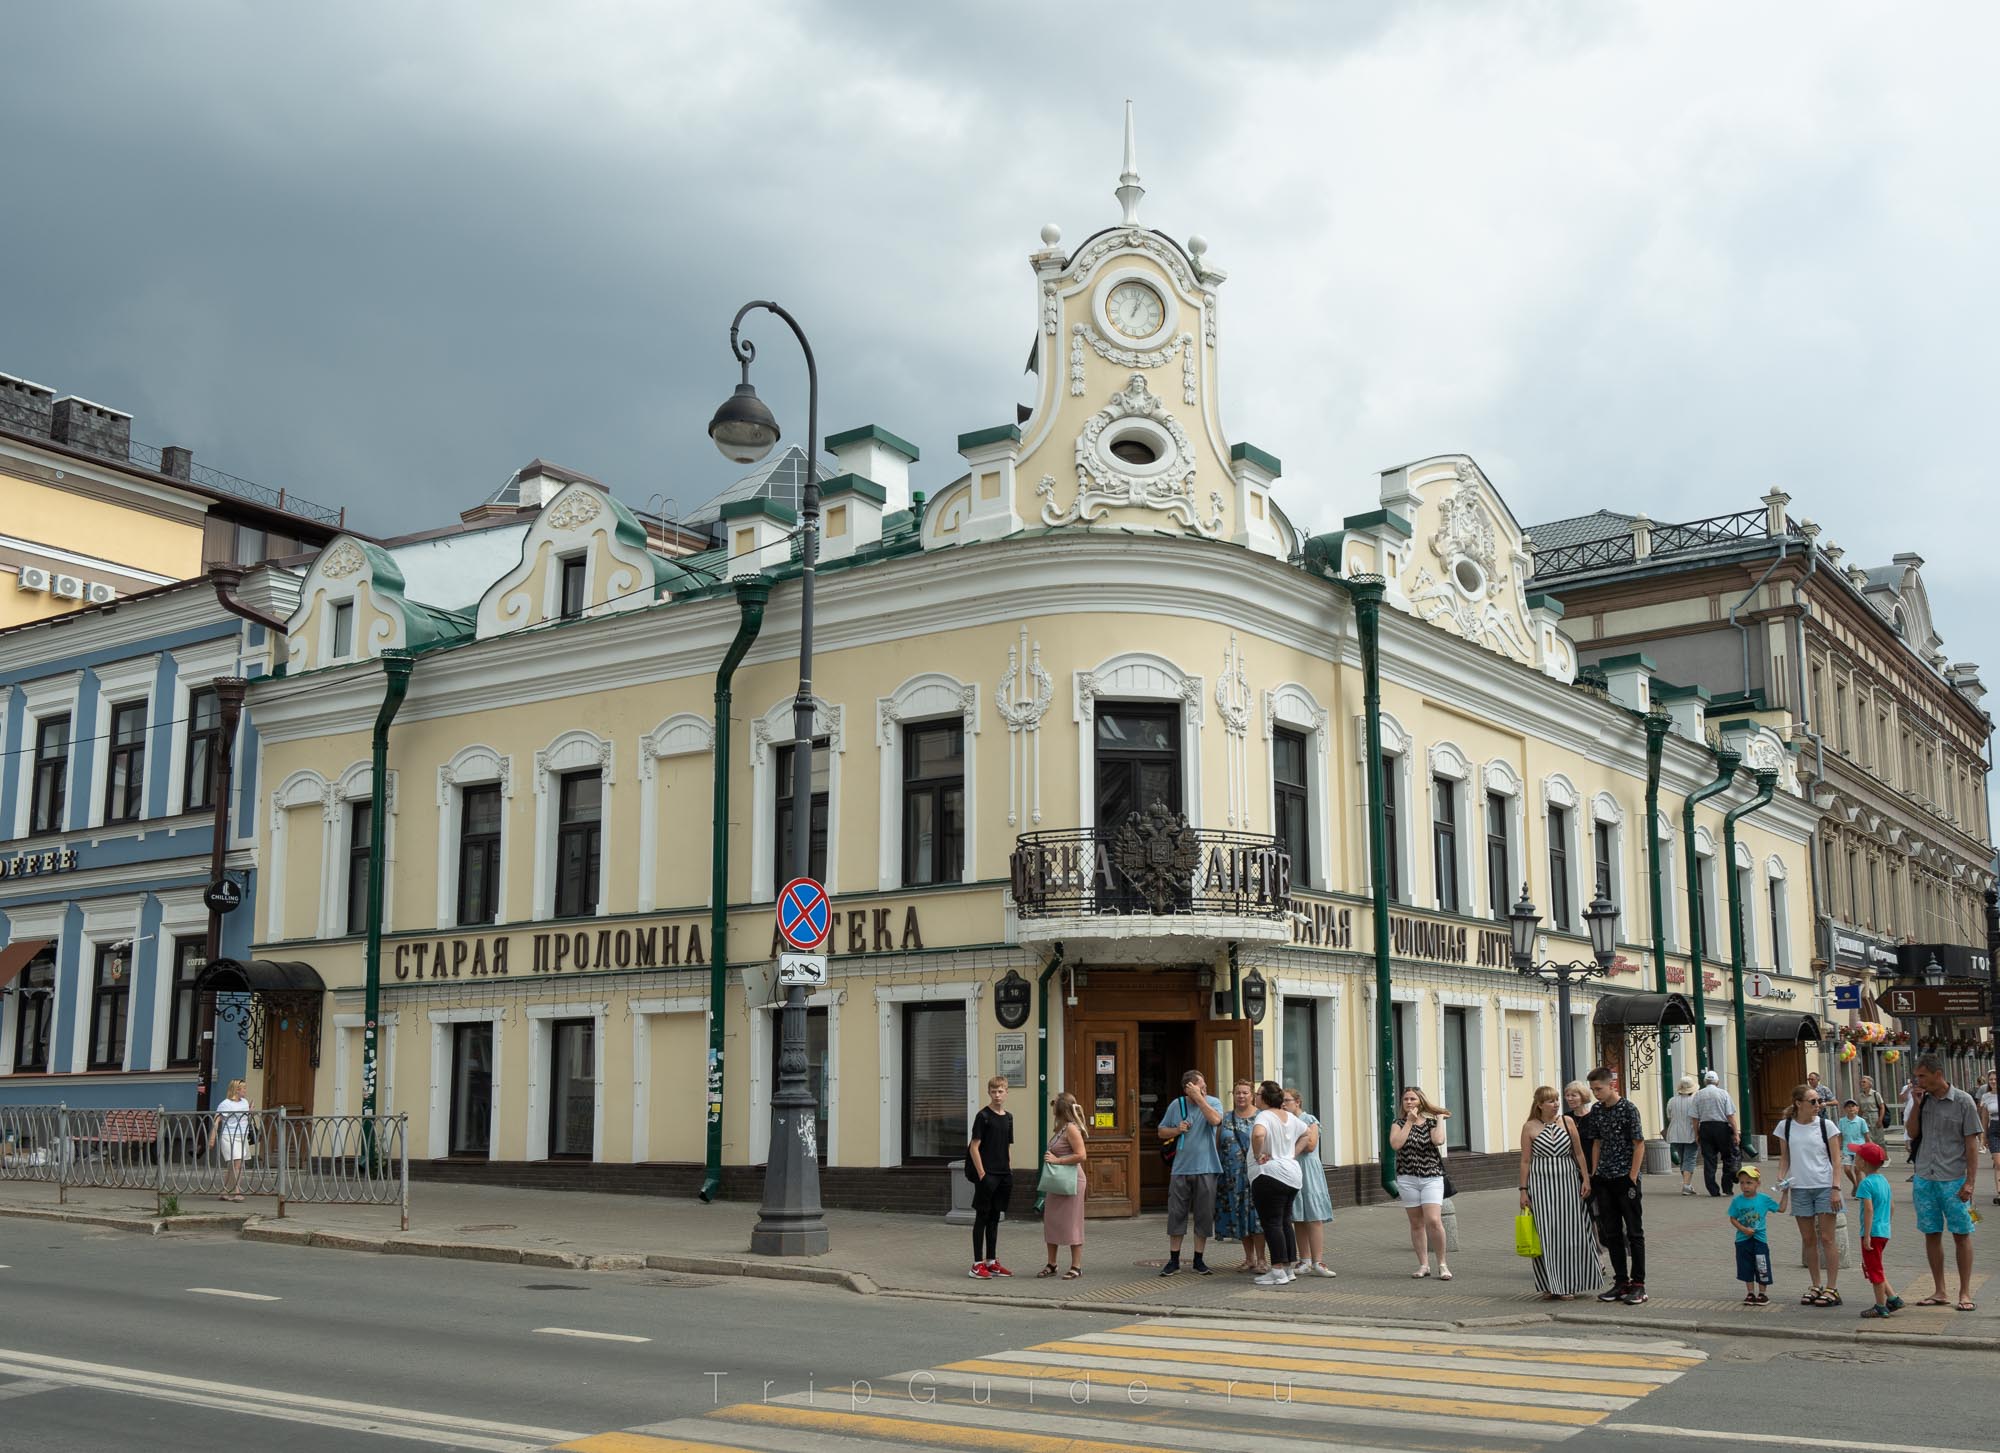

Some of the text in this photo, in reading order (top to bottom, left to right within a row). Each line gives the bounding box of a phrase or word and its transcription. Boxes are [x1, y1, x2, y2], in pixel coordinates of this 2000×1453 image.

[0, 849, 77, 878] FFEE
[395, 906, 924, 979] СТАРАЯ ПРОЛОМНА АТЕКА
[1284, 899, 1353, 948] ТАРАЯ
[1386, 916, 1468, 964] РОЛОМНАЯ
